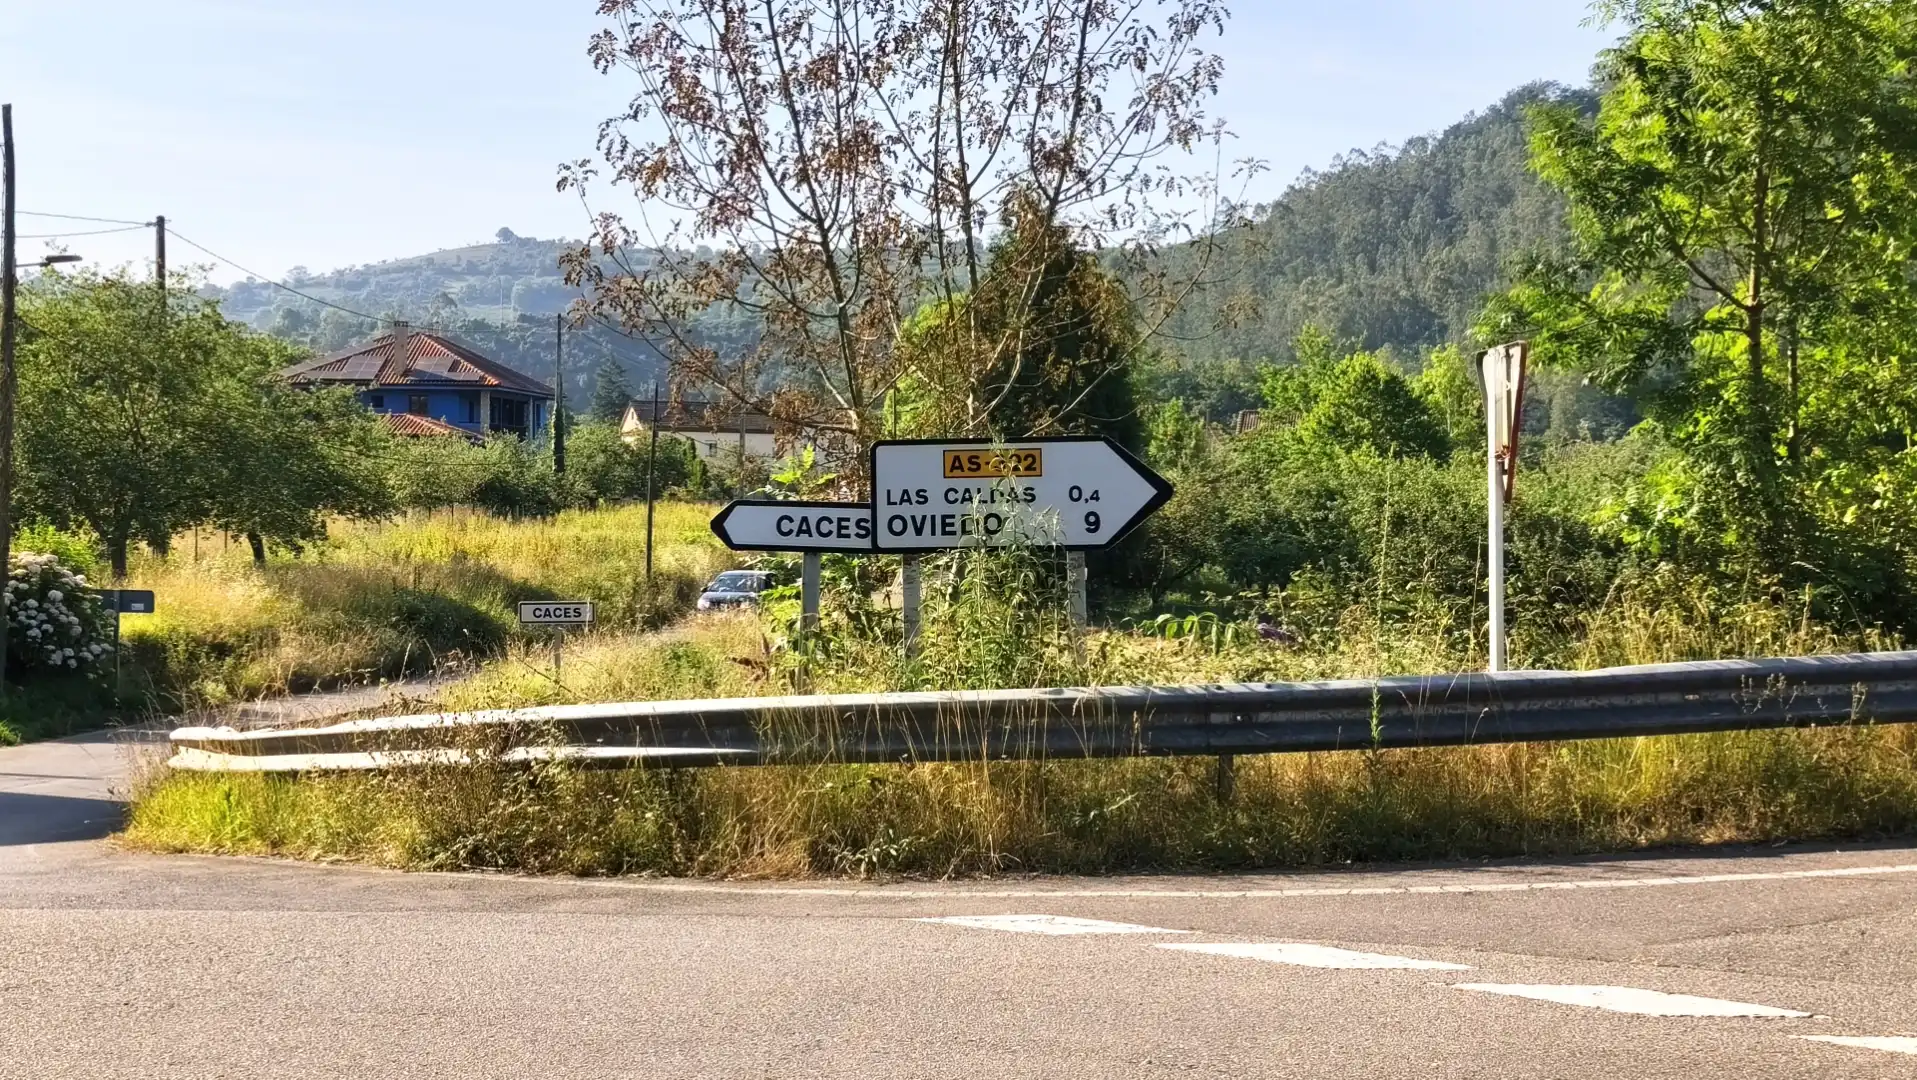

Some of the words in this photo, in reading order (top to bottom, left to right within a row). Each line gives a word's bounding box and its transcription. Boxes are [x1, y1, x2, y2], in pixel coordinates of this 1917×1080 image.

[887, 488, 929, 505] LAS
[944, 486, 1036, 505] CALDAS
[1069, 485, 1100, 503] 0,4
[776, 514, 871, 539] CACES
[887, 512, 1002, 537] OVIEDO
[1084, 511, 1101, 533] 9
[532, 607, 582, 619] CACES
